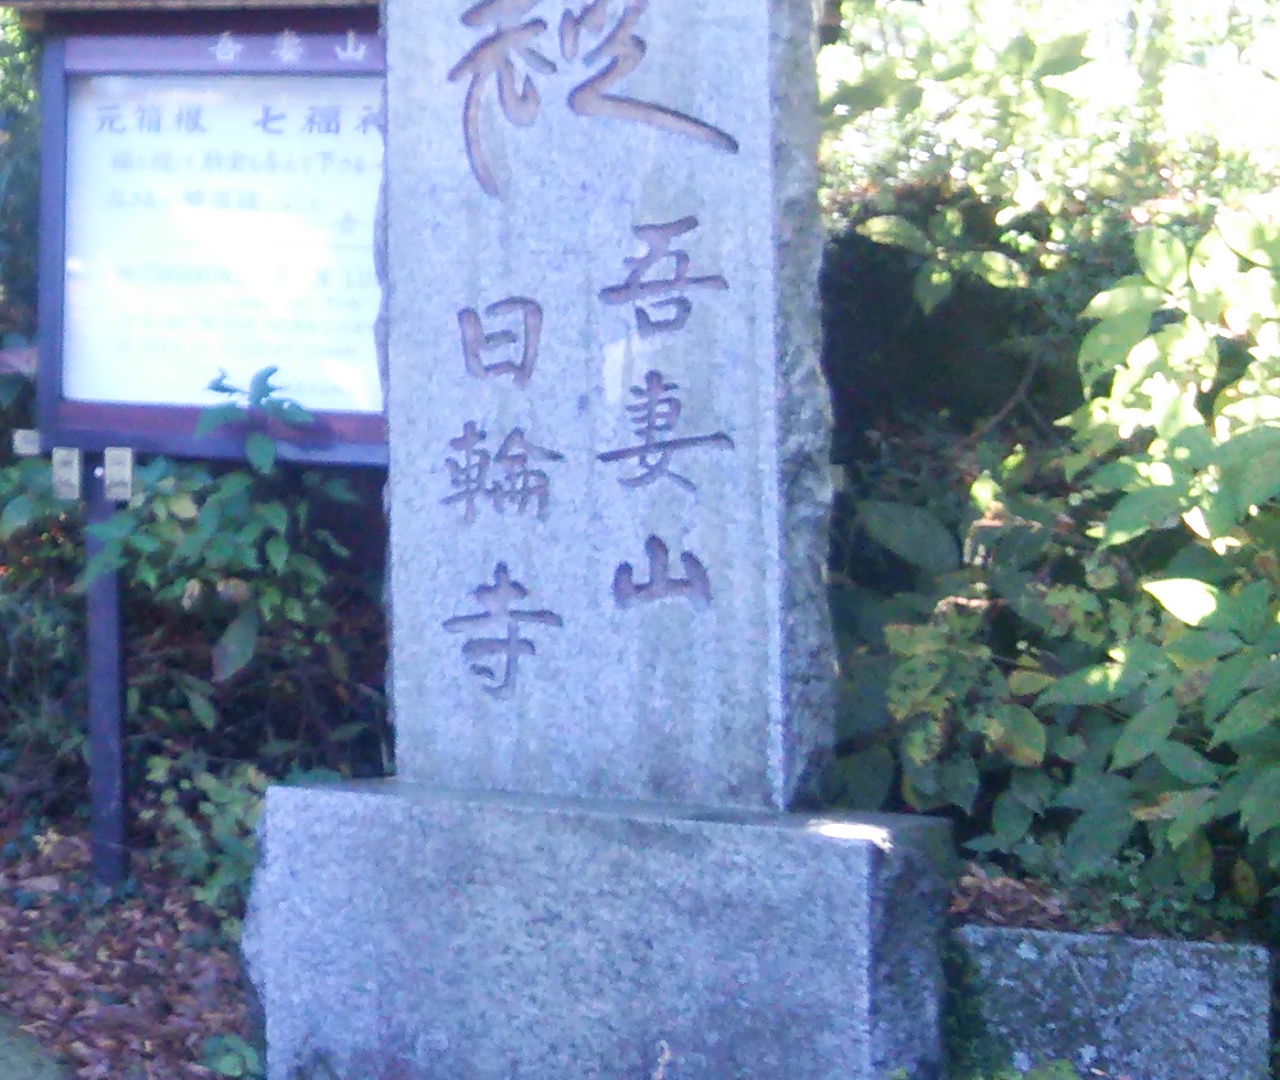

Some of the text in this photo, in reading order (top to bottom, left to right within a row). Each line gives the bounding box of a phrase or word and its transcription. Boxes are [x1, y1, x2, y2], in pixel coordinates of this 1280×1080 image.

[441, 295, 566, 699] 日輪寺
[597, 215, 736, 610] 吾妻山
